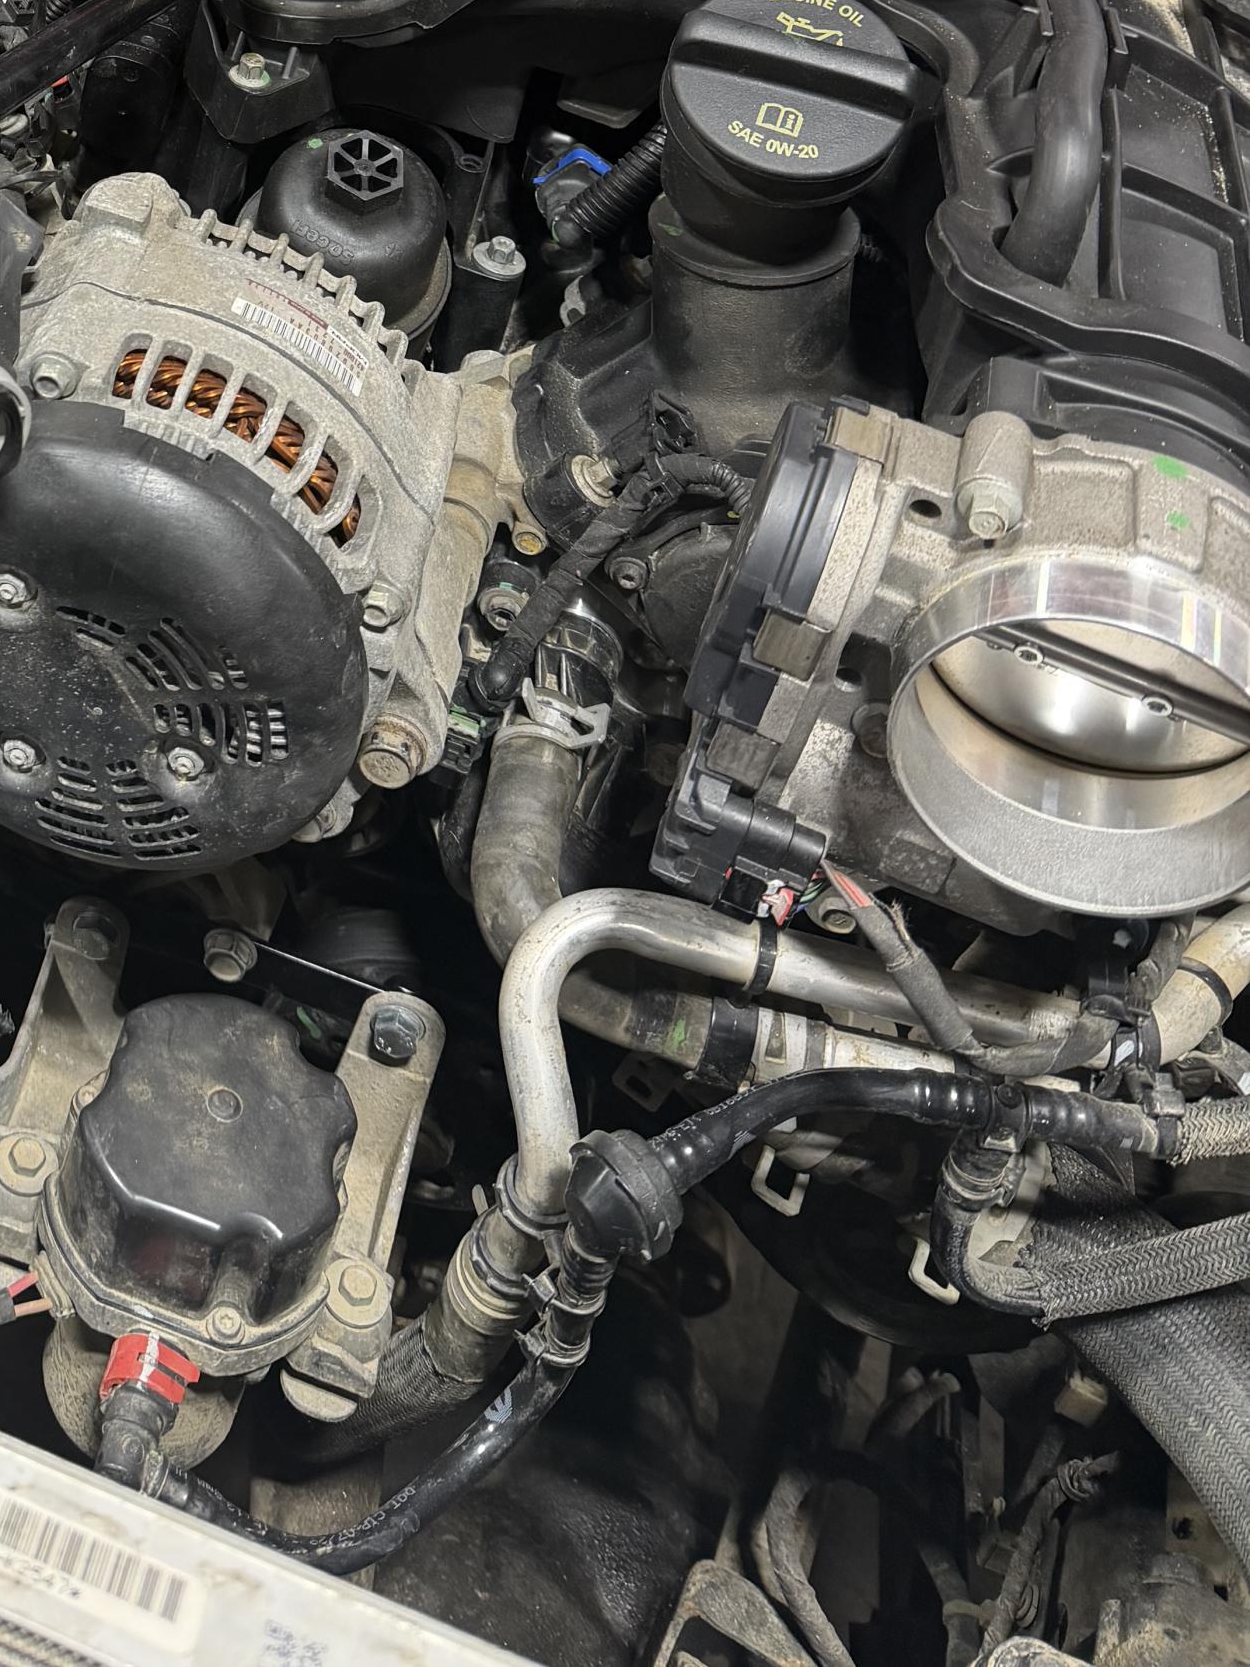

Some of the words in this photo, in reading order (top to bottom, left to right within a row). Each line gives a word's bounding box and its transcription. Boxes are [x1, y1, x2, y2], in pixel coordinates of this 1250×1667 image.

[839, 5, 865, 28] OIL
[728, 120, 764, 148] SAE
[765, 138, 819, 158] 0W-20
